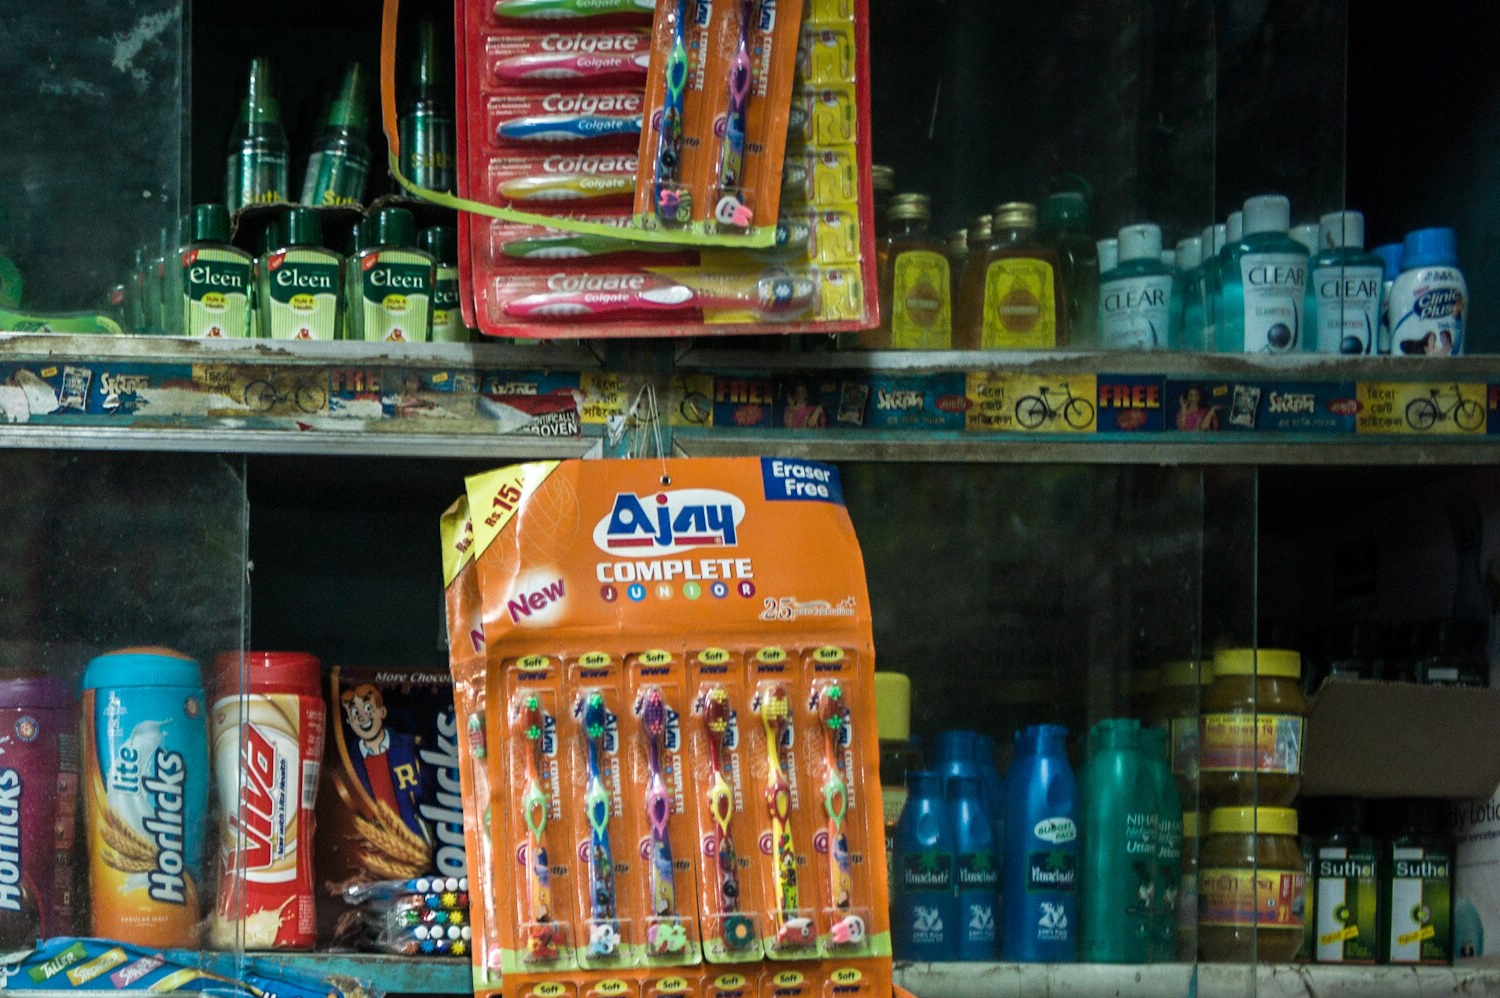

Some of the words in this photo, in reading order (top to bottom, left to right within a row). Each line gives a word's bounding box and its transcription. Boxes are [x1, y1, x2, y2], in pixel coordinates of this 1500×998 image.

[541, 33, 639, 55] Colgate
[542, 94, 640, 114] Colgate
[578, 118, 624, 131] Colgate
[542, 154, 639, 175] Colgate
[547, 273, 645, 293] Colgate
[1248, 265, 1306, 287] CLEAR
[1320, 279, 1378, 299] CLEAR
[1104, 289, 1165, 312] CLEAR
[1100, 384, 1161, 409] FREE
[772, 461, 831, 483] Eraser
[784, 478, 830, 499] Free
[606, 492, 739, 547] Ajay
[596, 558, 754, 583] COMPLETE
[506, 576, 567, 624] New
[523, 656, 544, 668] Soft
[705, 651, 723, 662] Soft
[374, 671, 408, 683] More
[111, 741, 141, 794] lite
[226, 722, 280, 875] VIVA
[548, 760, 562, 821] COMPLETE
[144, 744, 186, 904] Horlicks
[1037, 821, 1073, 836] BUDGET
[1055, 830, 1076, 841] PACK
[1319, 860, 1376, 878] Suthol
[1395, 860, 1449, 878] Suthol
[39, 953, 79, 980] TALLER
[72, 955, 119, 984] STRONGER
[837, 970, 856, 982] Soft
[539, 983, 559, 995] Soft
